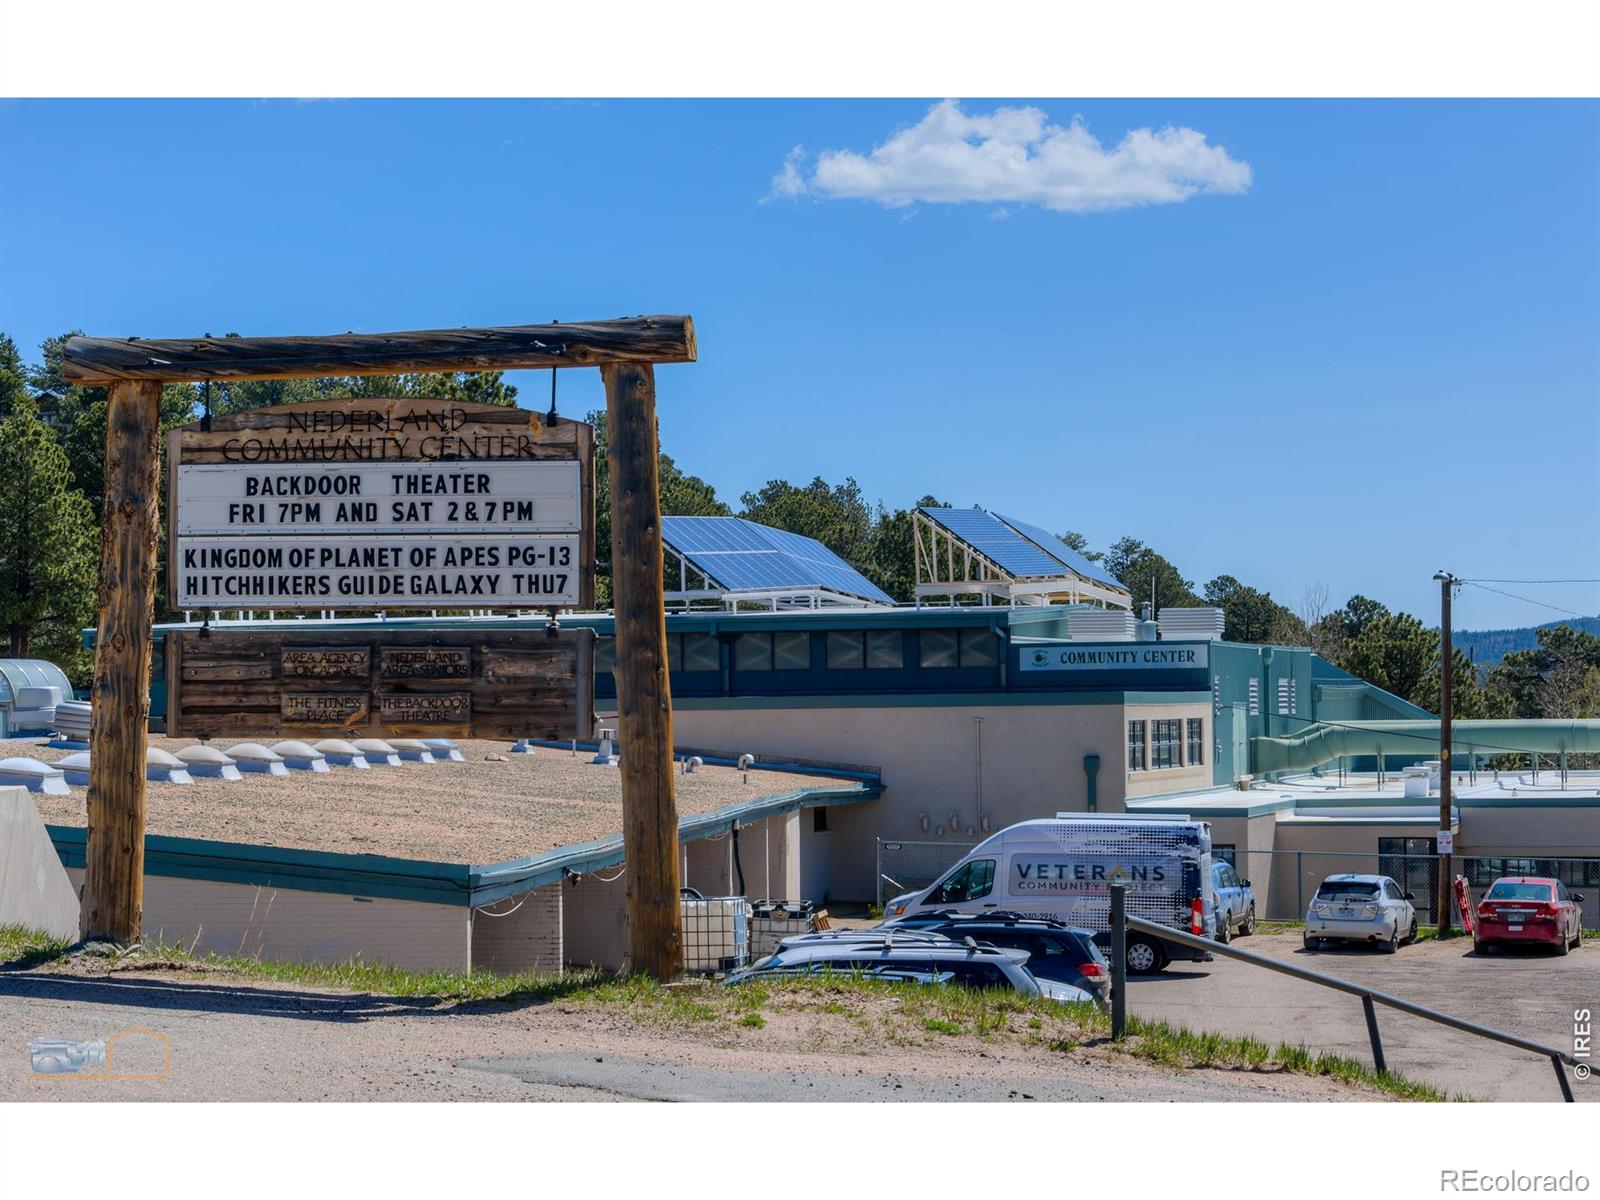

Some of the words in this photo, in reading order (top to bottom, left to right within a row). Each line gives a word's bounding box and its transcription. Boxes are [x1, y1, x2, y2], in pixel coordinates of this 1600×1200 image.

[288, 408, 467, 433] NEDERLAND
[222, 437, 410, 462] COMMUNITY
[419, 435, 535, 459] CENTER
[246, 475, 361, 497] BACKDOOR
[391, 473, 491, 495] THEATER
[229, 503, 265, 524] FRI
[278, 502, 321, 523] 7PM
[335, 502, 378, 523] AND
[391, 501, 433, 522] SAT
[184, 548, 283, 569] KINGDOM
[288, 547, 315, 568] OF
[320, 547, 403, 568] PLANET
[409, 547, 437, 568] OF
[443, 546, 500, 567] APES
[508, 546, 571, 567] PG-13
[186, 575, 331, 596] HITCHHIKERS
[337, 574, 405, 596] GUIDE
[410, 574, 501, 595] GALAXY
[283, 652, 316, 664] AREA
[319, 652, 368, 664] AGENCY
[1060, 650, 1138, 665] COMMUNITY
[1143, 649, 1196, 663] CENTER
[288, 697, 312, 709] THE
[317, 697, 362, 709] FITNESS
[306, 710, 344, 721] PLACE
[401, 710, 451, 721] THEATRE
[1016, 863, 1165, 881] VETERANS
[1018, 881, 1099, 890] COMMUNITY
[1106, 882, 1164, 891] POJECT
